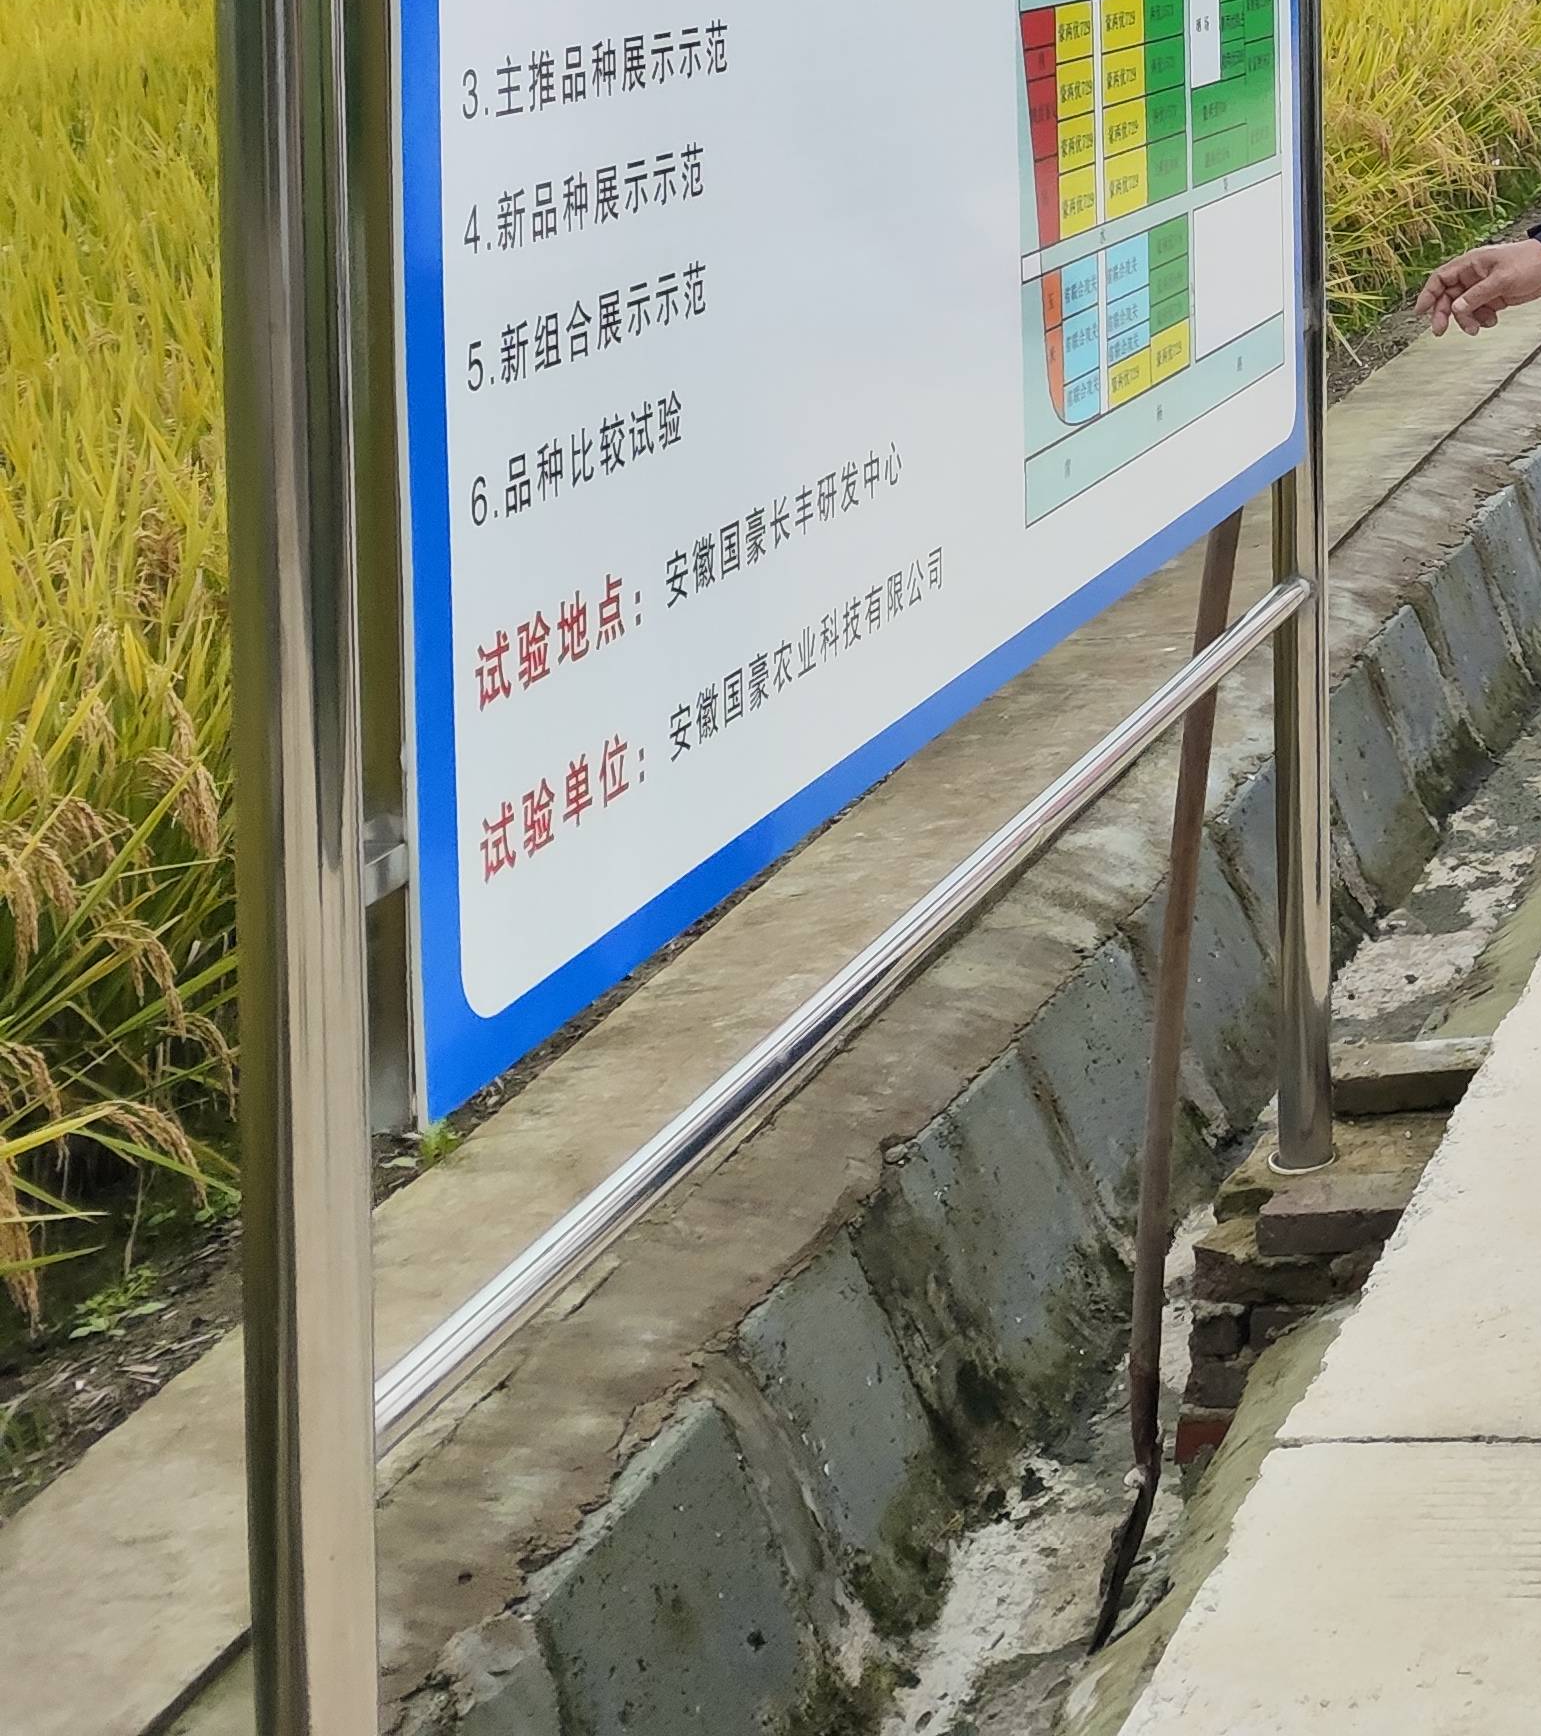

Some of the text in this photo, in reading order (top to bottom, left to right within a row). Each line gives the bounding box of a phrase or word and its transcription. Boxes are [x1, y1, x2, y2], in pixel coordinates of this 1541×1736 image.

[461, 19, 729, 120] 3.主推品种展示示范
[463, 141, 705, 255] 4.新品种展示示范
[466, 260, 707, 392] 5.新组合展示示范
[470, 390, 683, 527] 6.品种比较试验
[666, 440, 903, 609] 安徽国豪长丰研发中心
[668, 545, 945, 763] 安徽国豪农业科技有限公司
